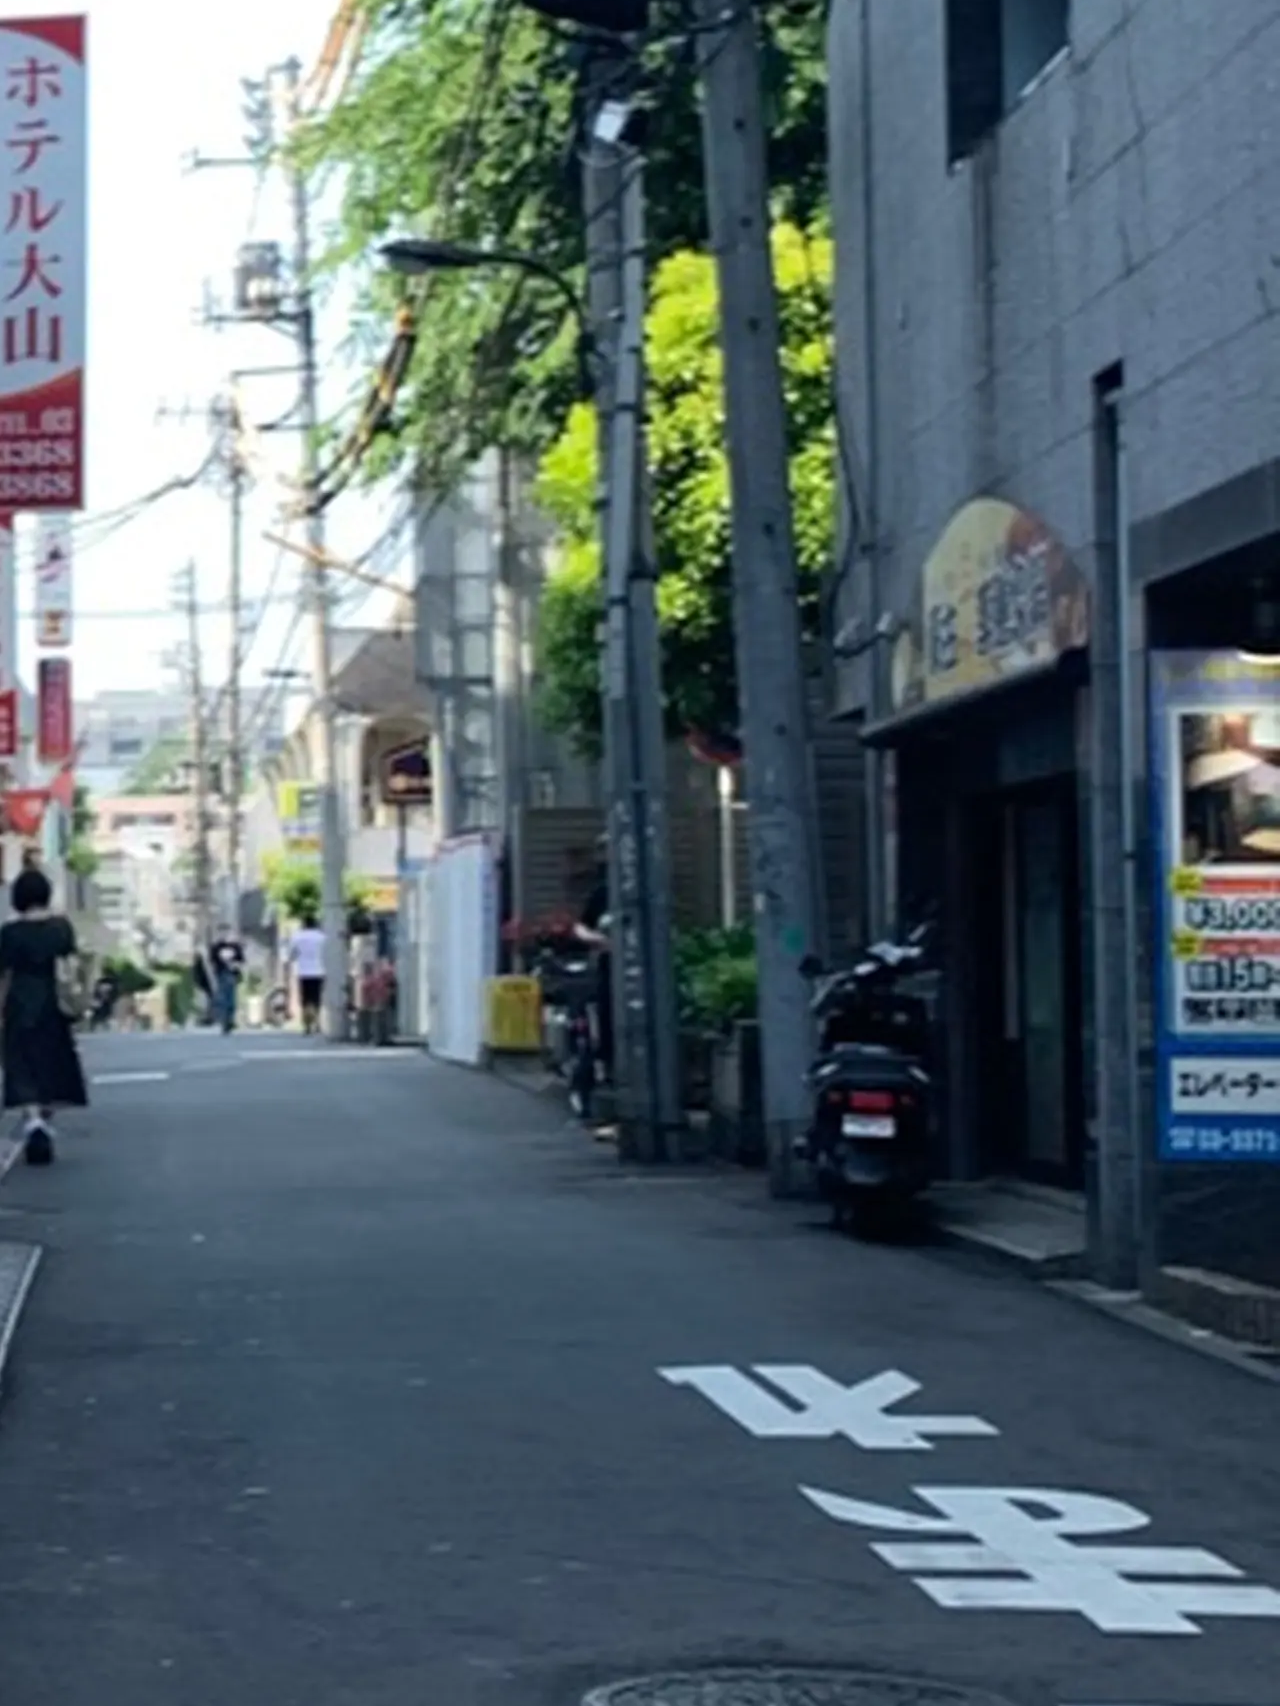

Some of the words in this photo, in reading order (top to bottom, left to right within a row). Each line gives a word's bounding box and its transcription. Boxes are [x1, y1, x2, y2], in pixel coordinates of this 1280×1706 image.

[4, 56, 64, 365] ホテル大山
